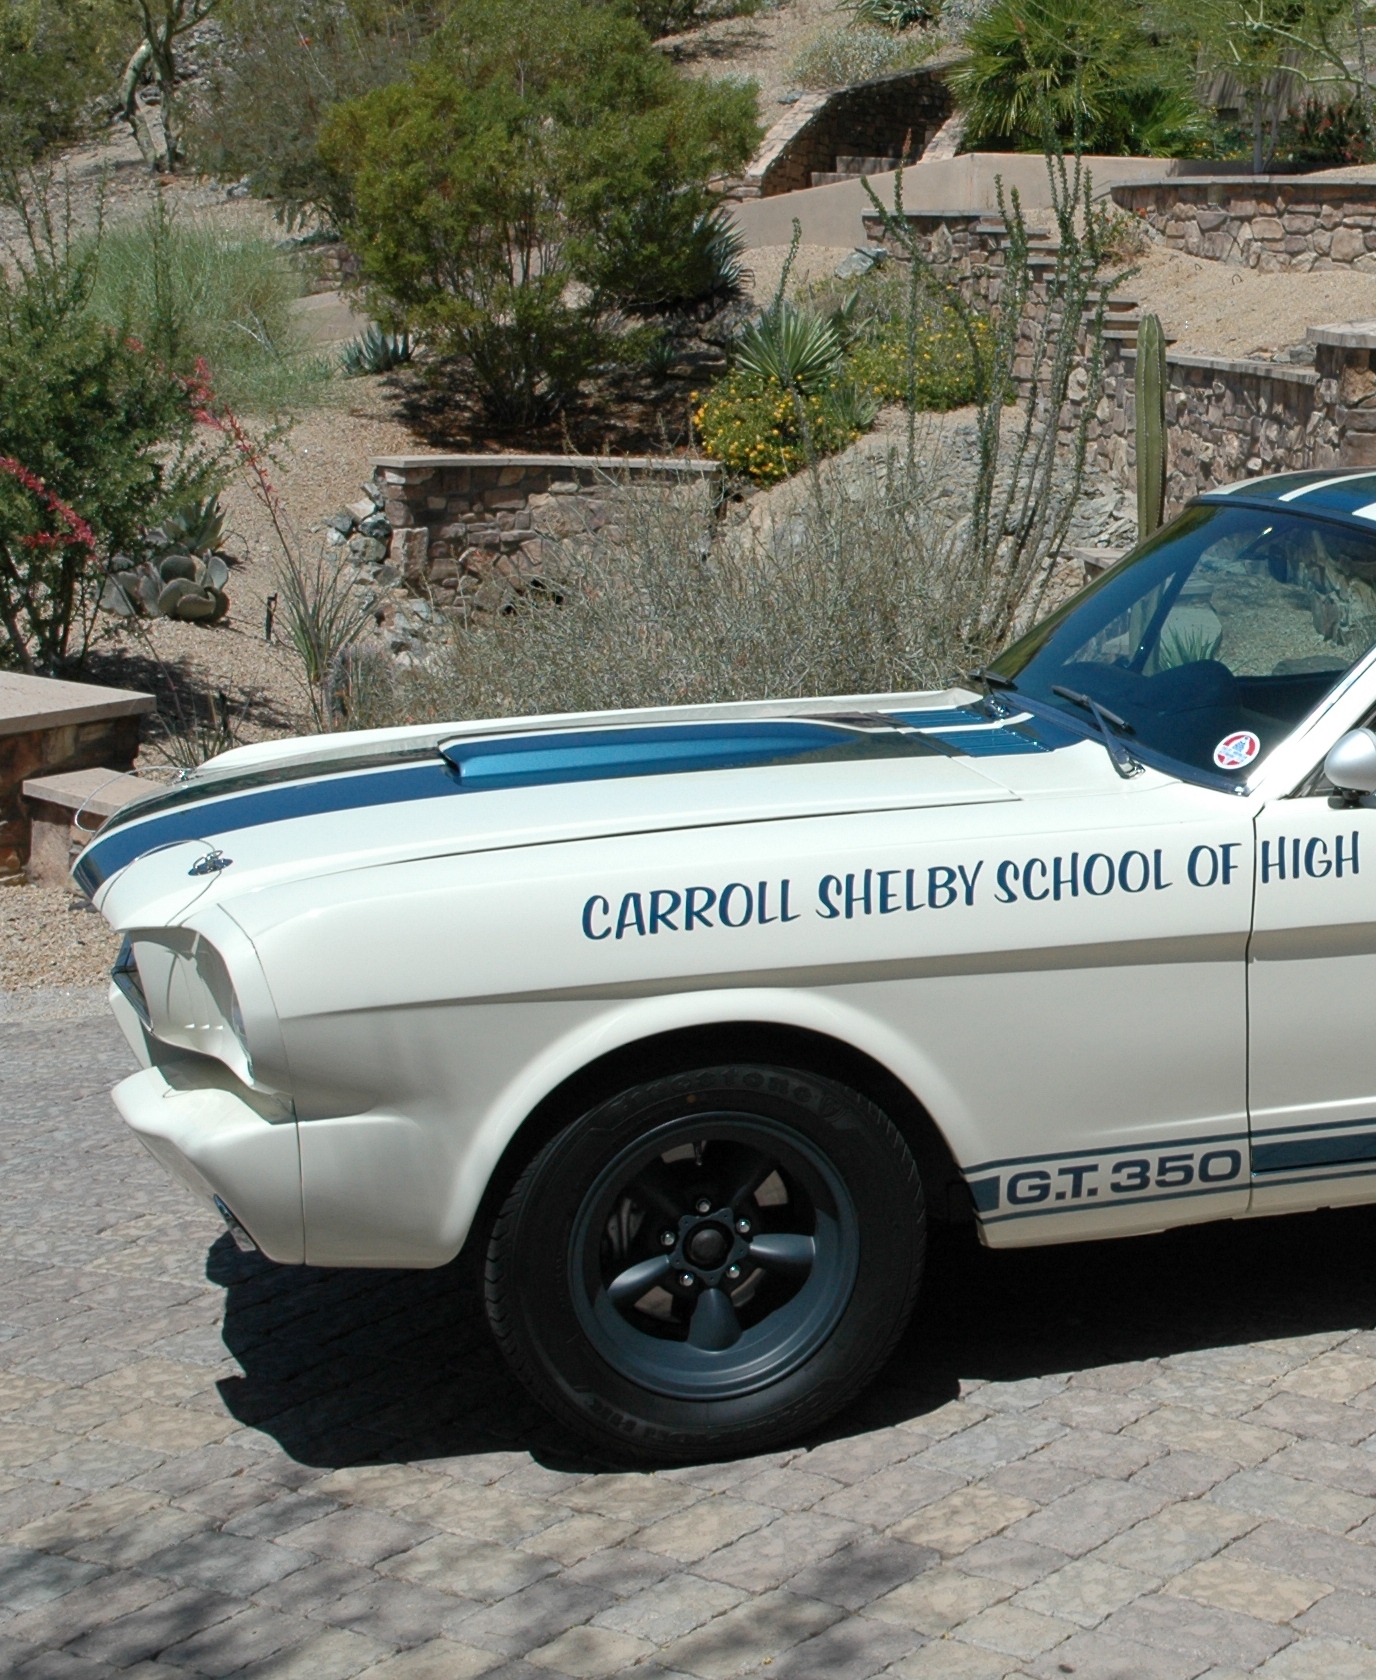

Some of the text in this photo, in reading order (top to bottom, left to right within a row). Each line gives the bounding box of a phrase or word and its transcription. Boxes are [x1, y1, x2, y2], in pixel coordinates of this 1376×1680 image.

[581, 879, 801, 942] CARROLL
[815, 860, 984, 920] SHELBY
[994, 848, 1173, 904] SCHOOL
[1187, 842, 1242, 888] OF
[1261, 830, 1361, 884] HIGH
[606, 1066, 814, 1113] restone
